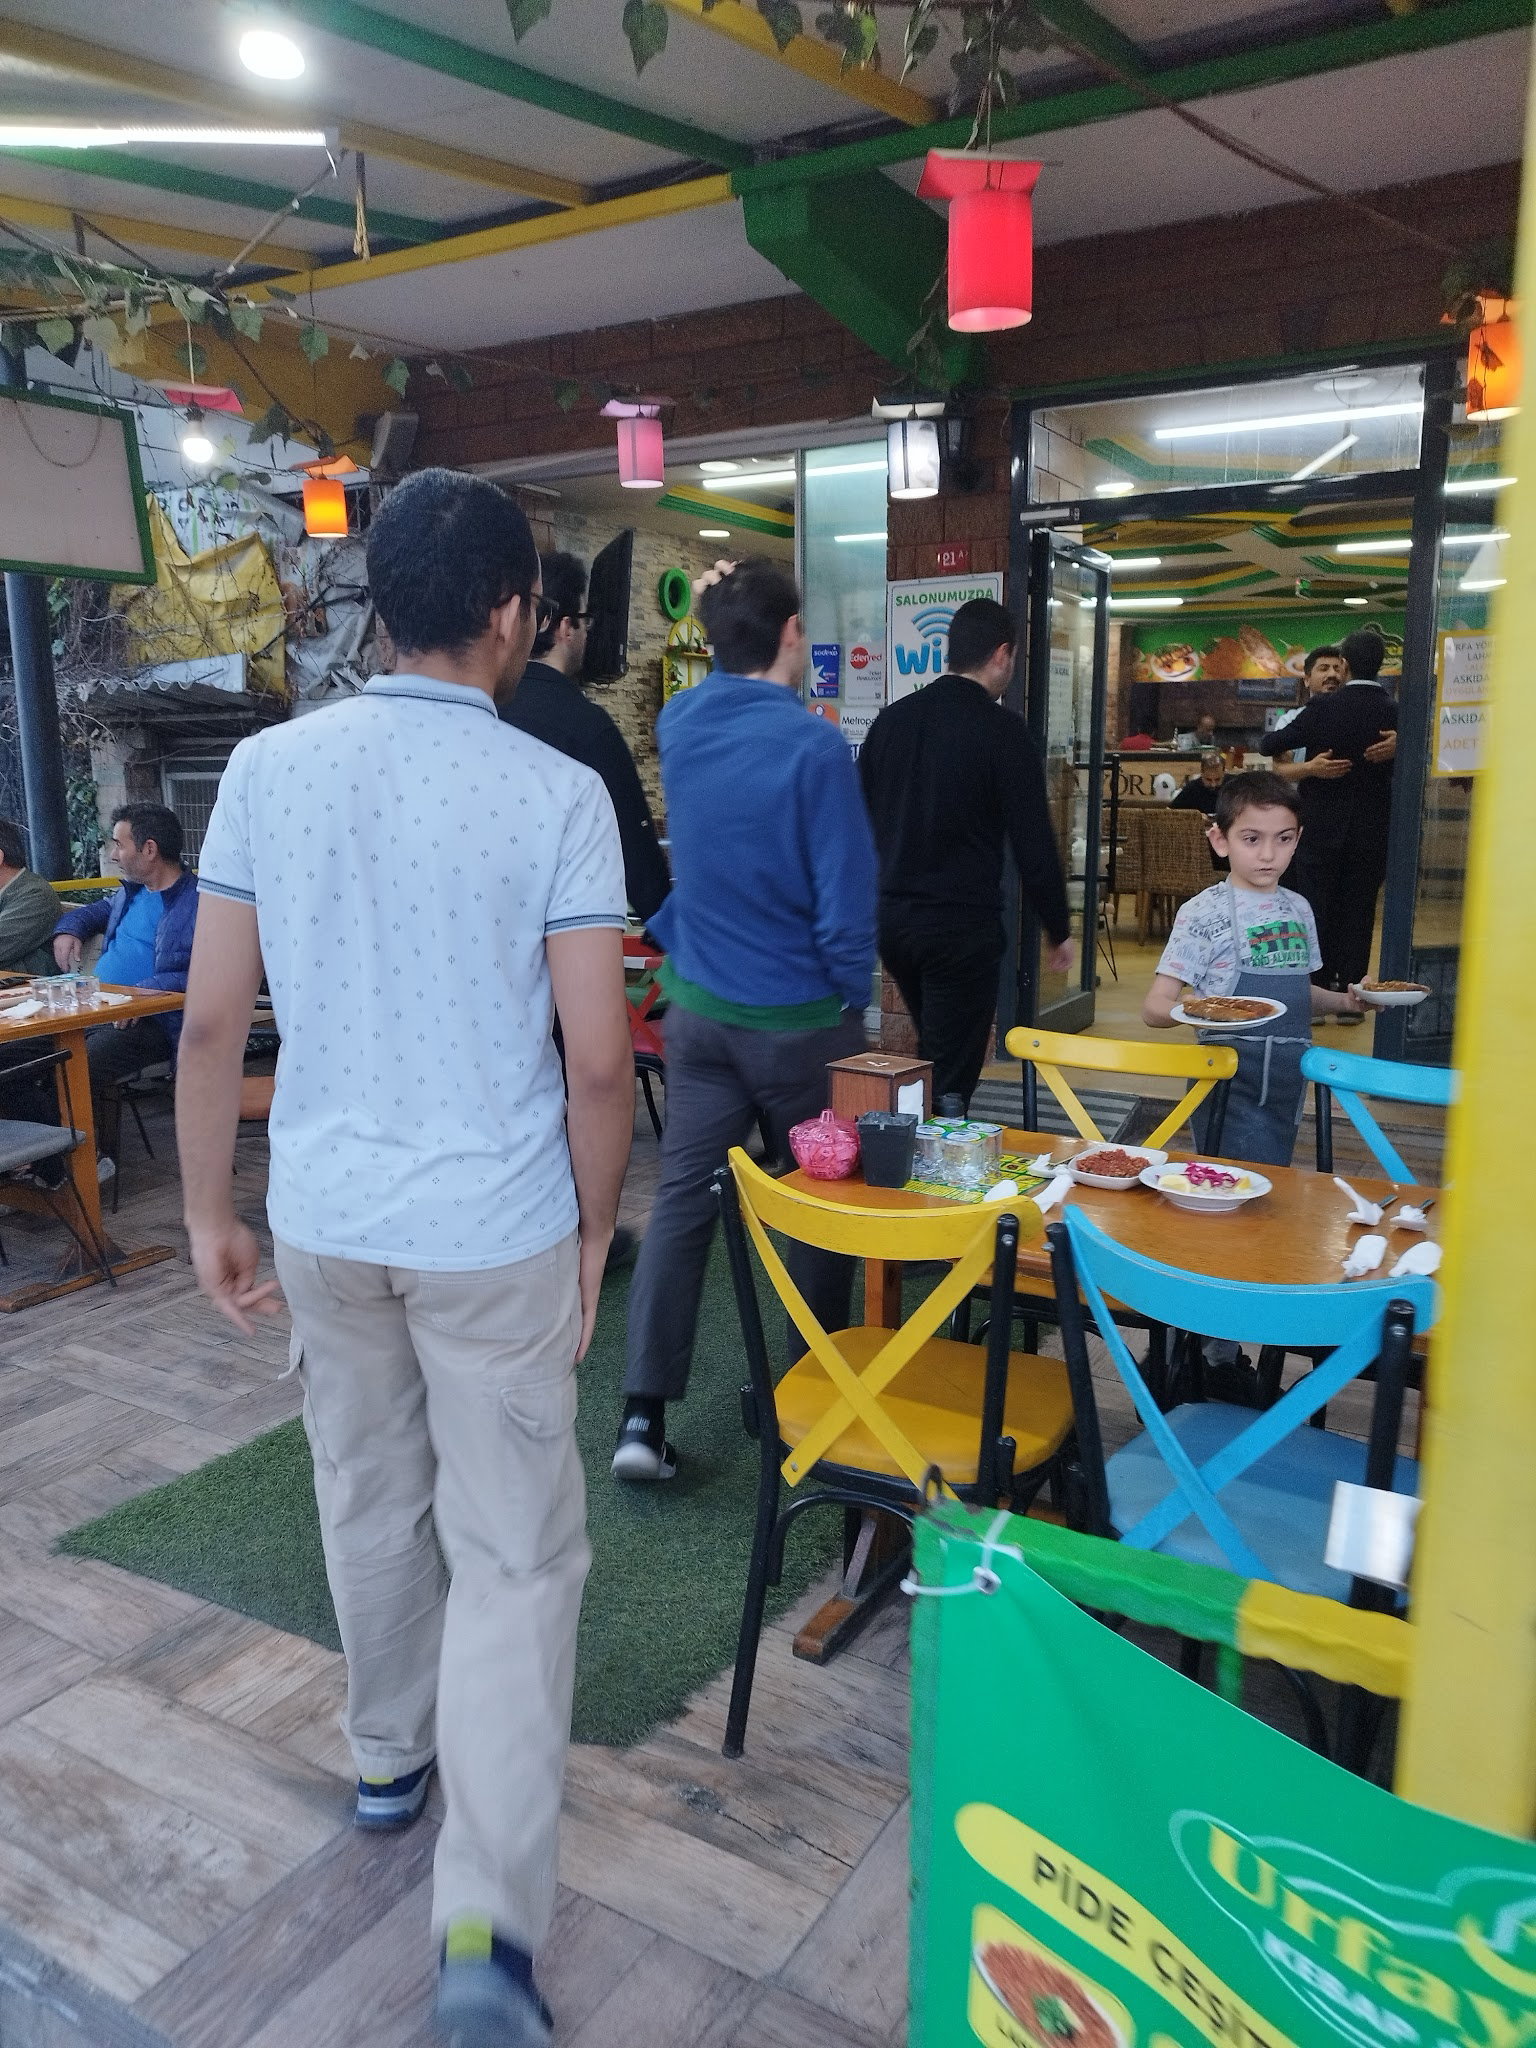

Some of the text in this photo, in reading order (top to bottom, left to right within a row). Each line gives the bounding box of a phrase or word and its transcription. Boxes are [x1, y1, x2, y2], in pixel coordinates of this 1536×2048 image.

[895, 588, 994, 606] SALONUMUZDA
[850, 653, 882, 663] Edenred
[1033, 1853, 1133, 1949] PİDE
